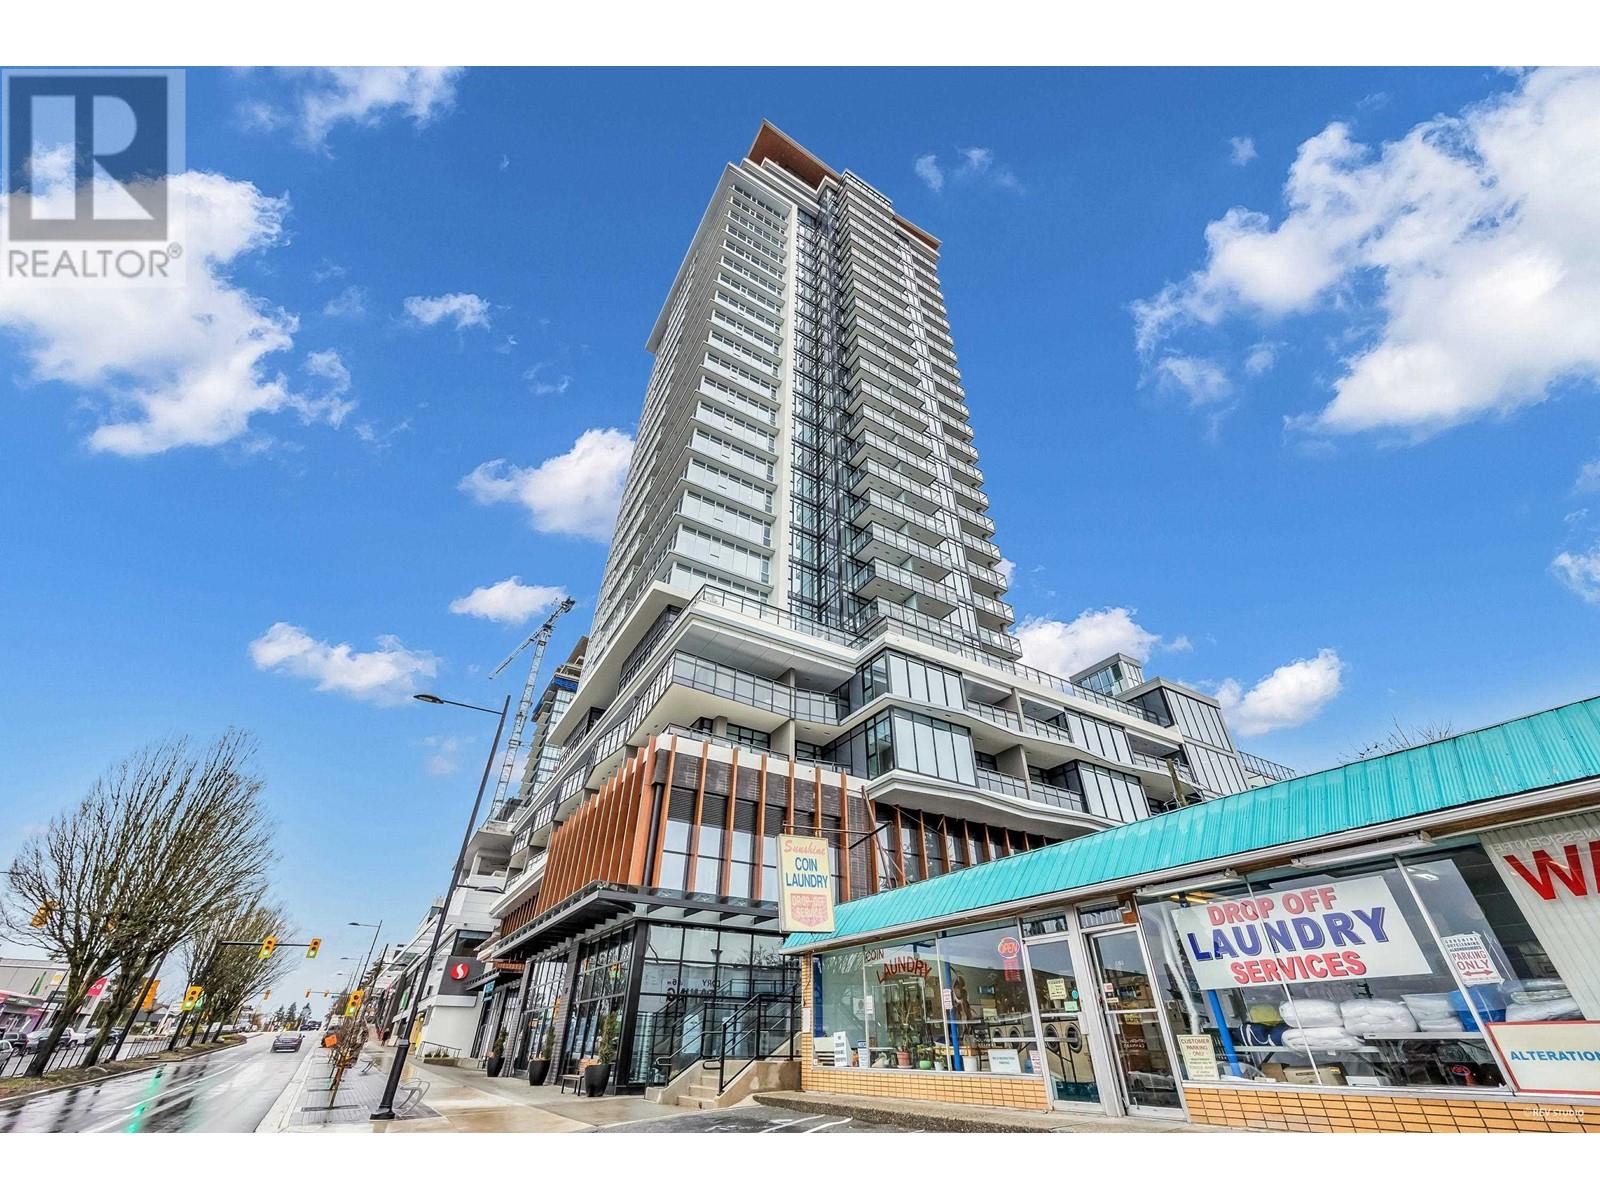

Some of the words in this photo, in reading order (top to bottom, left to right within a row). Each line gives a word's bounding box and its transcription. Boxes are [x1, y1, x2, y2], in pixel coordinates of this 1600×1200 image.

[784, 840, 825, 855] Sunshine
[795, 857, 818, 872] COIN
[785, 872, 828, 888] LAUNDRY
[1207, 896, 1275, 926] DROP
[1282, 886, 1337, 915] OFF
[1187, 906, 1389, 962] LAUNDRY
[865, 949, 885, 962] COIN
[1452, 951, 1487, 961] PARKING
[876, 956, 932, 984] LAUNDRY
[1230, 950, 1367, 984] SERVICES
[1457, 959, 1490, 971] ONLY
